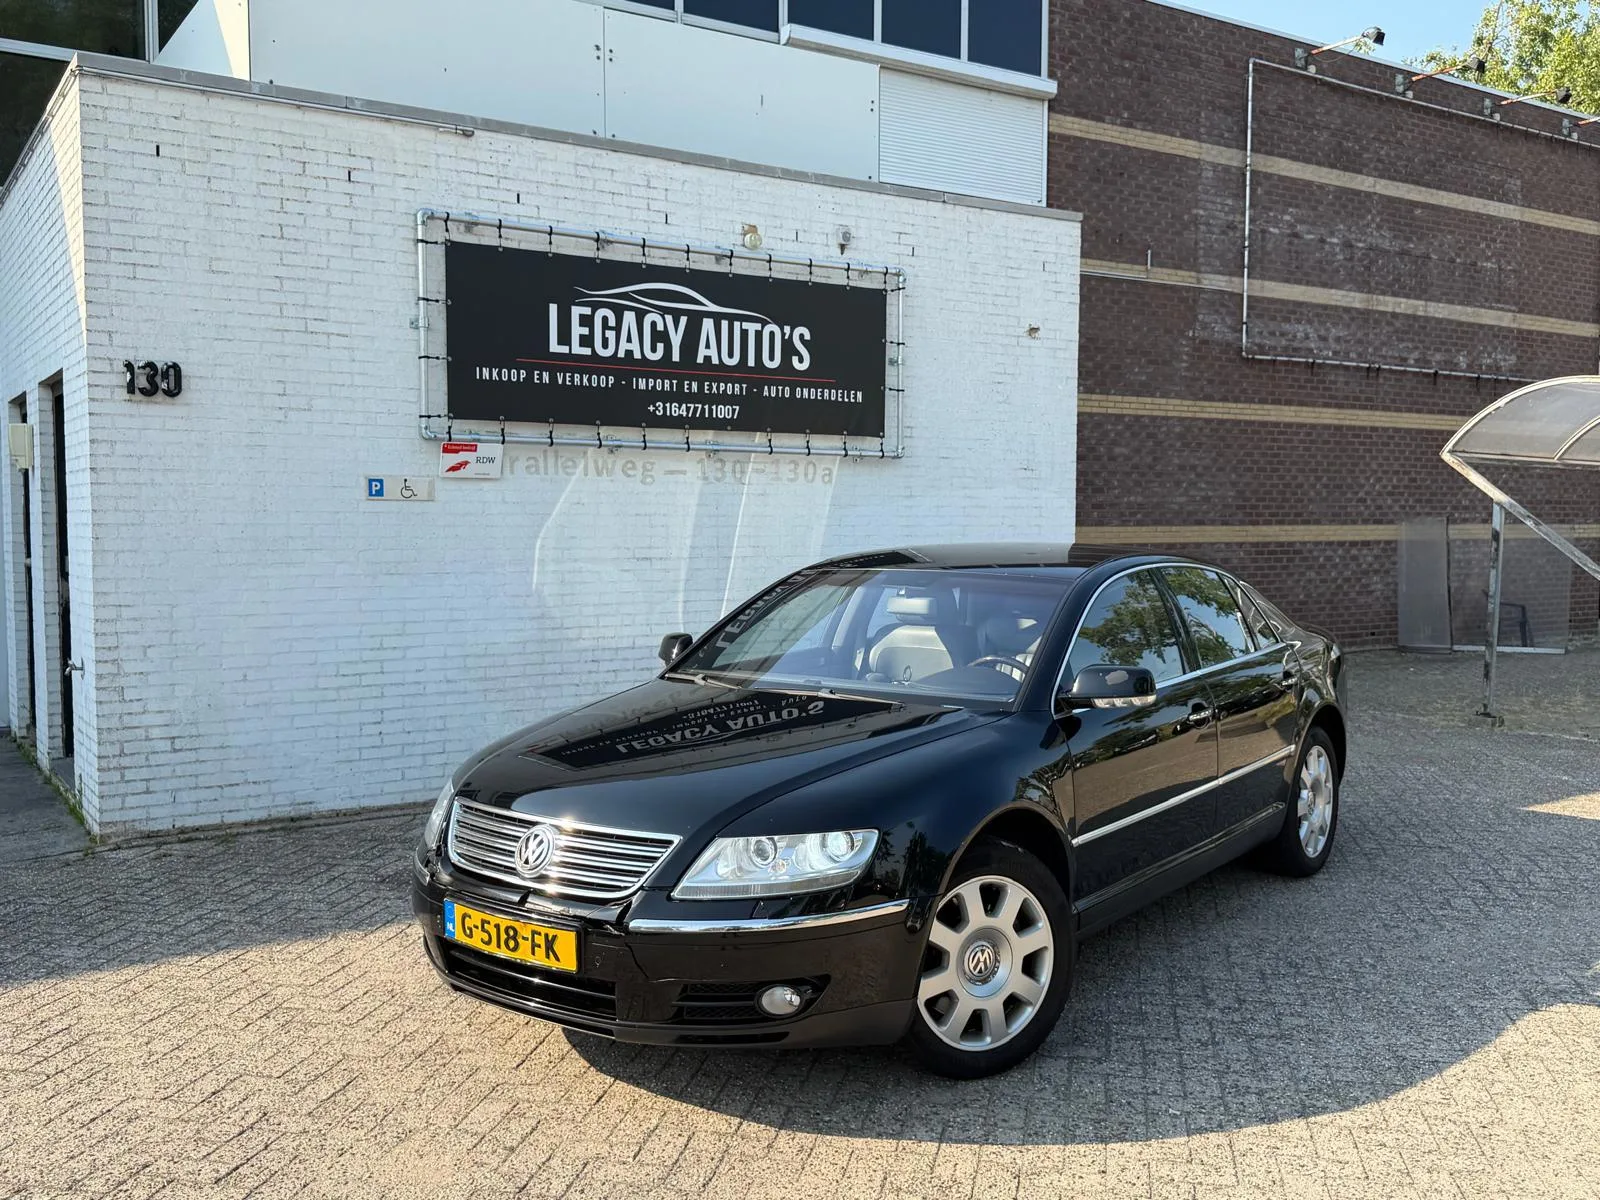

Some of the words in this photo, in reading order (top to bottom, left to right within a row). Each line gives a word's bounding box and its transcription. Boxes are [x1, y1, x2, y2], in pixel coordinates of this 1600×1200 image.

[549, 303, 687, 362] LEGACY
[696, 317, 811, 371] AUTO'S
[123, 360, 182, 398] 130
[476, 366, 527, 382] INKOOP
[534, 370, 550, 384] EN
[557, 372, 615, 388] VERKOOP
[632, 377, 678, 392] IMPORT
[684, 380, 698, 393] EN
[704, 381, 747, 396] EXPORT
[763, 385, 790, 398] AUTO
[795, 387, 863, 403] ONDERDELEN
[647, 402, 740, 419] +31647711007
[475, 456, 496, 464] RDW
[501, 449, 656, 485] rallelweg
[371, 482, 381, 494] P
[461, 912, 561, 962] G-518-FK
